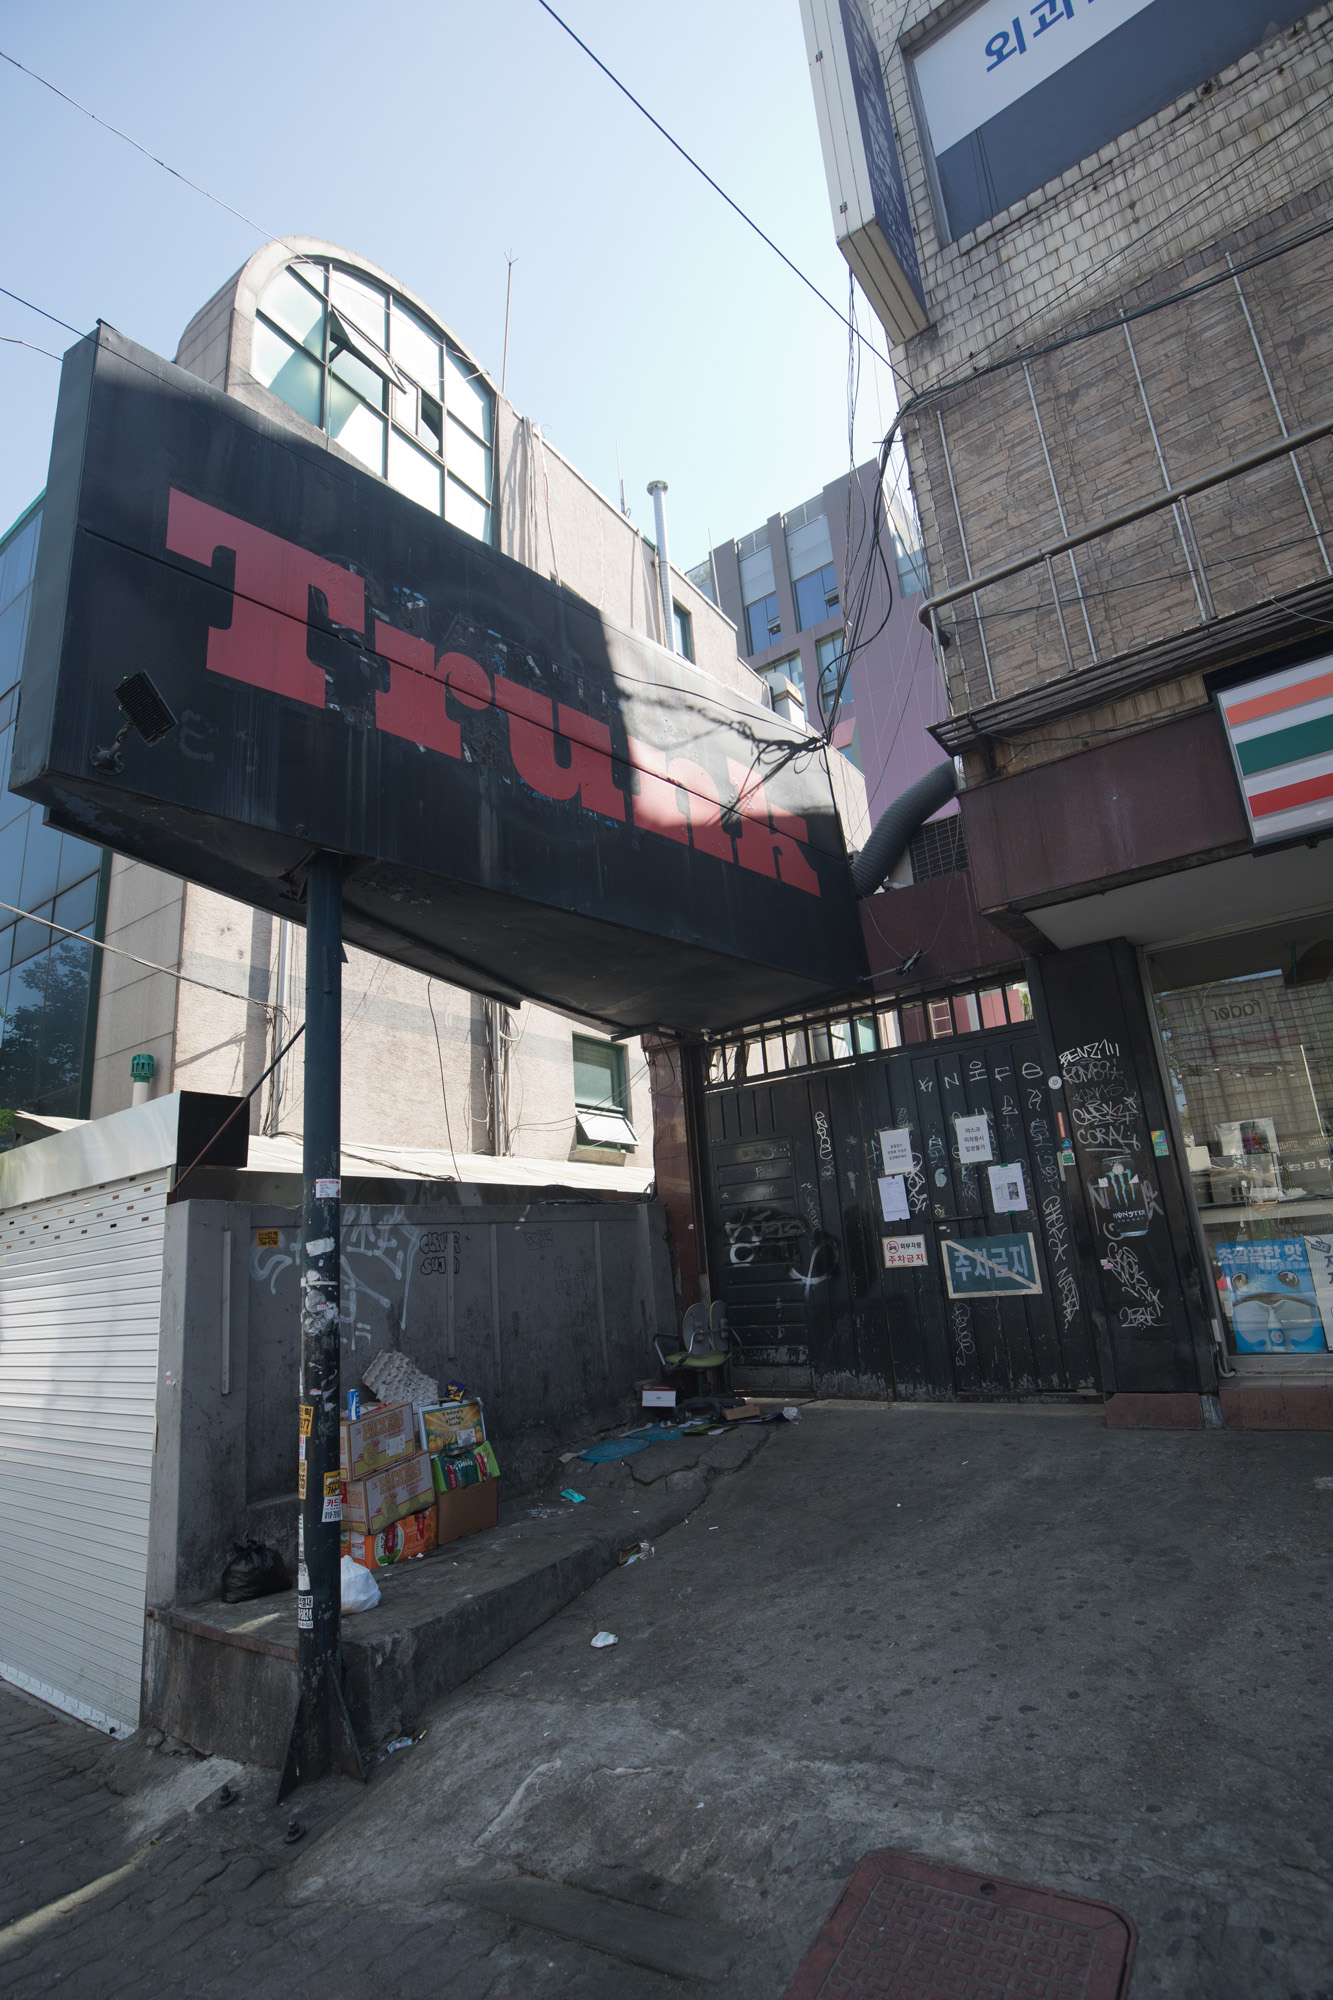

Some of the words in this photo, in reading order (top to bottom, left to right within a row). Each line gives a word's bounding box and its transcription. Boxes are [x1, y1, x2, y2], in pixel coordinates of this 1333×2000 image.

[166, 487, 820, 897] Trunk
[965, 1126, 981, 1134] 마스크
[965, 1144, 986, 1152] 입장불가
[1112, 1209, 1146, 1219] MONSTER
[888, 1253, 925, 1265] 주차금지
[954, 1244, 1030, 1282] 주차금지
[1218, 1245, 1281, 1265] 초깔끔한
[1283, 1243, 1303, 1262] 맛
[362, 1410, 404, 1441] PACKERS
[379, 1460, 422, 1495] PACKERS
